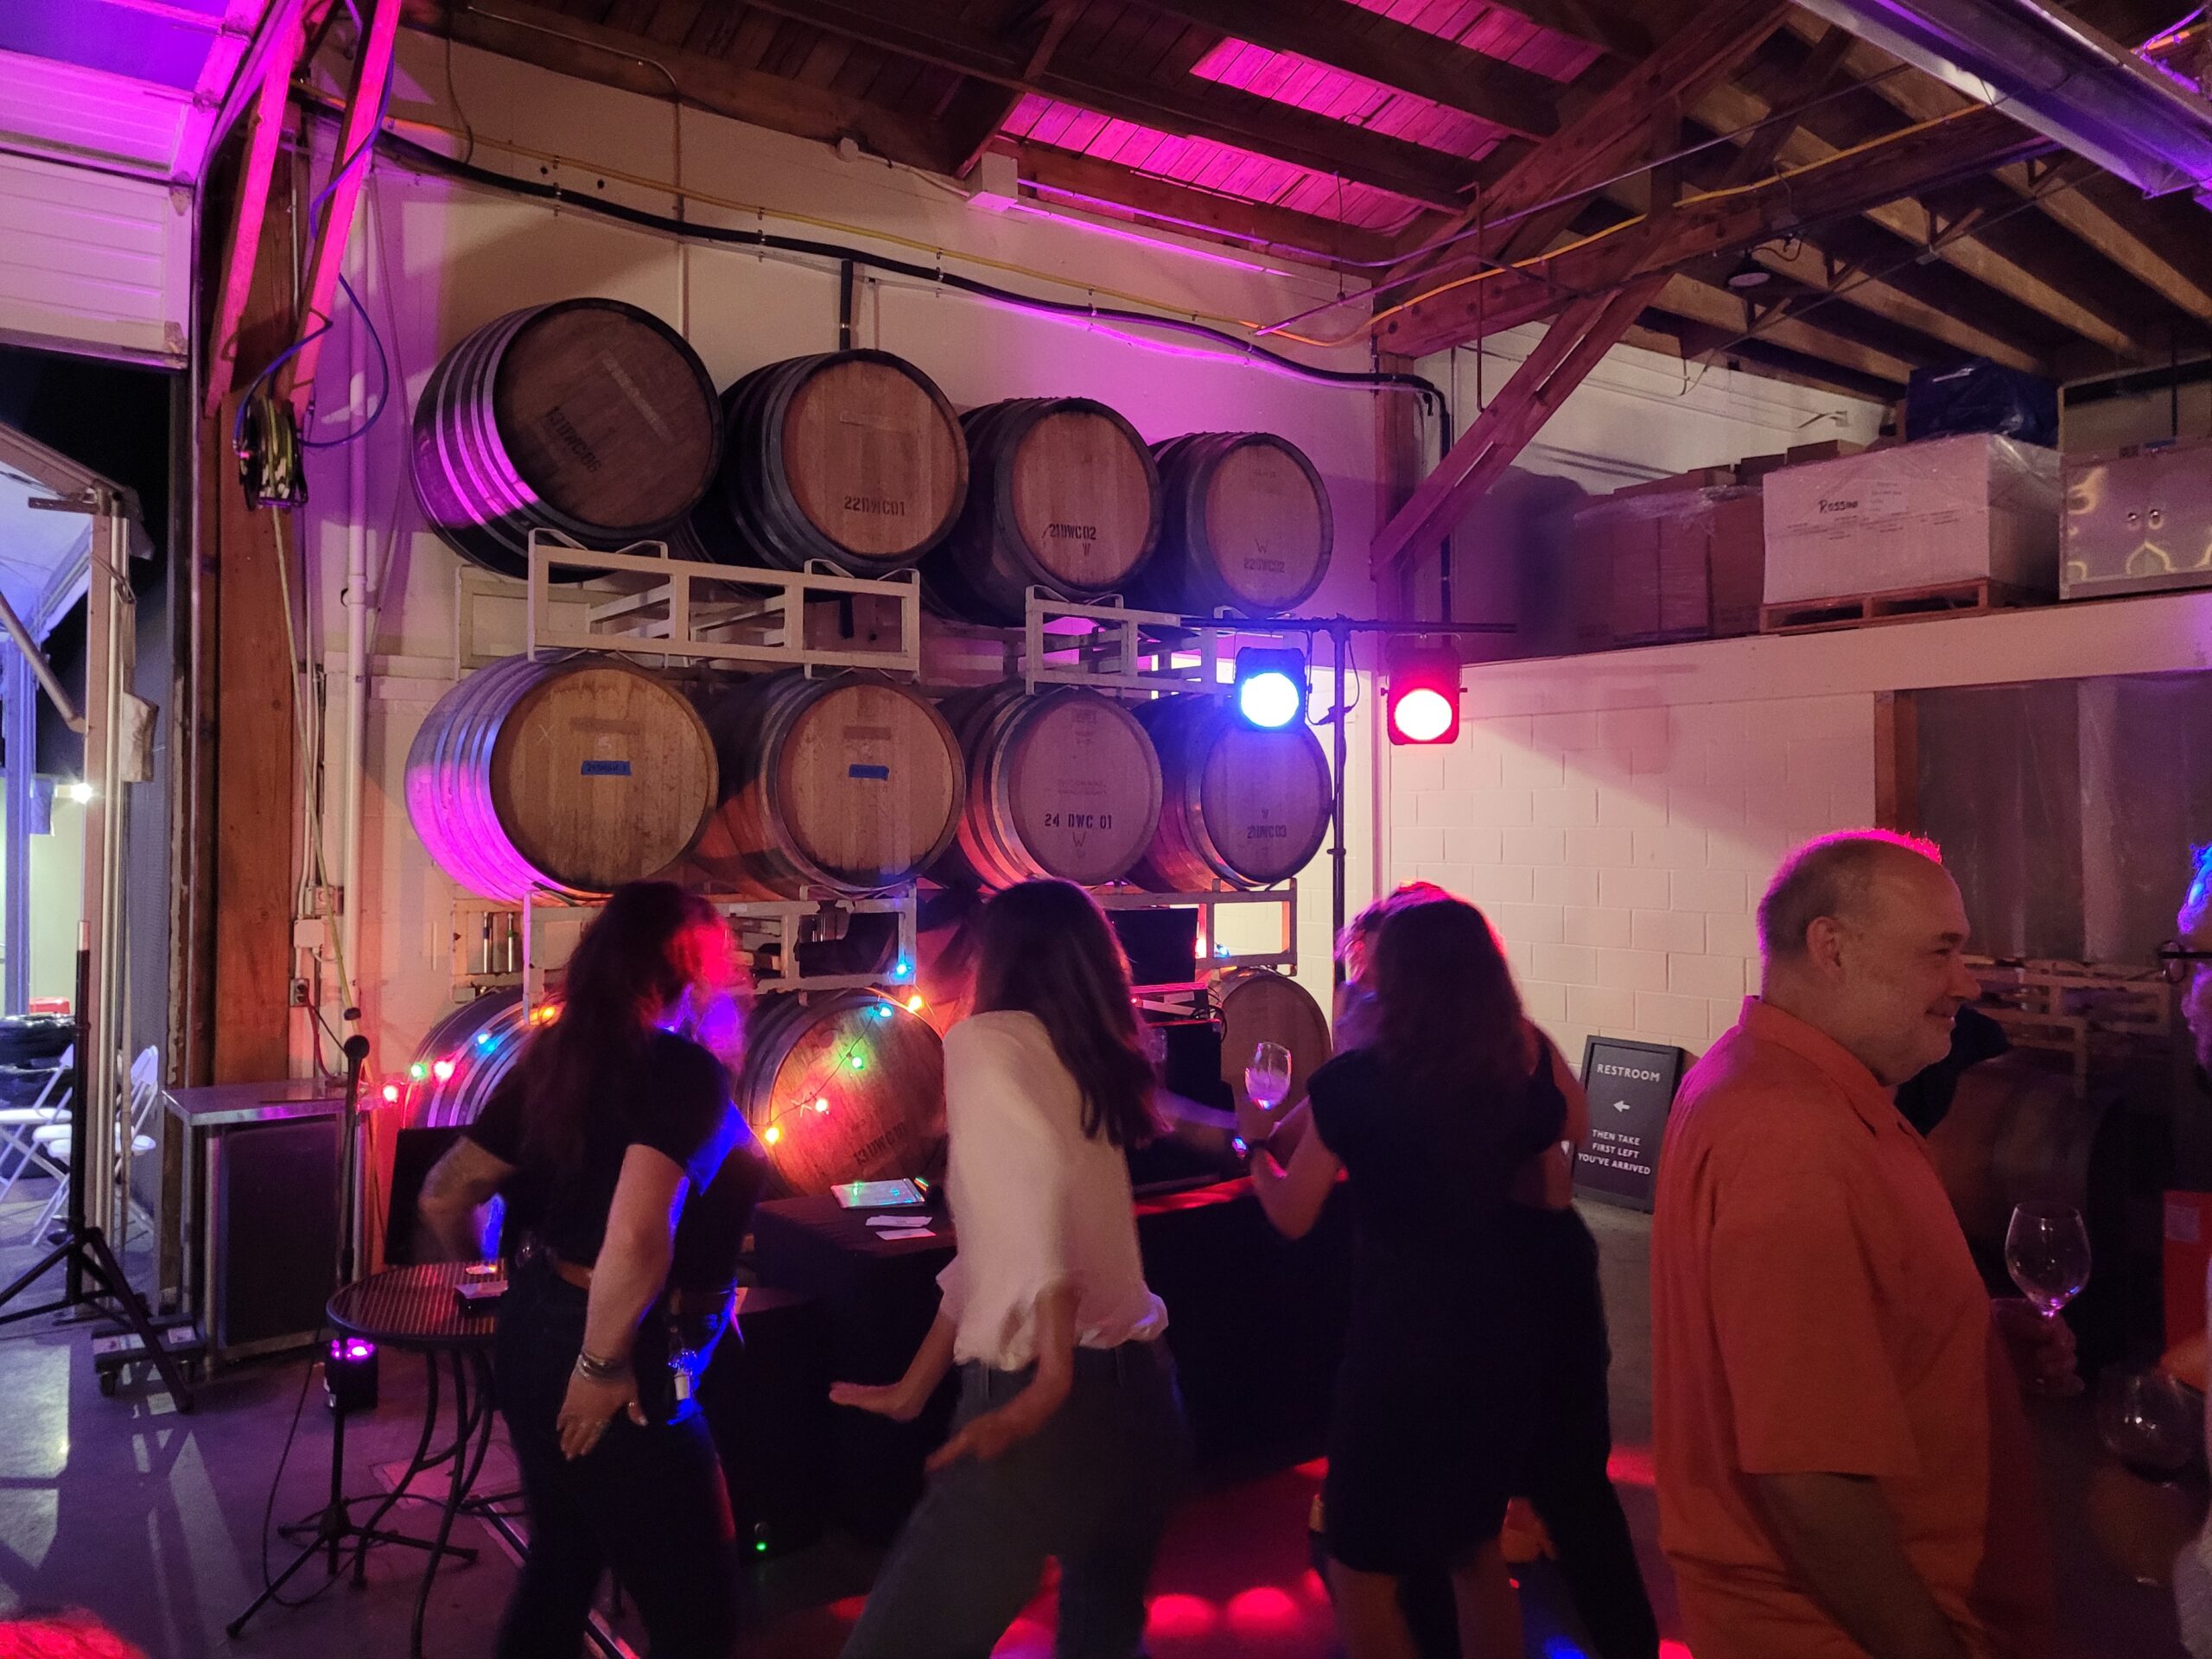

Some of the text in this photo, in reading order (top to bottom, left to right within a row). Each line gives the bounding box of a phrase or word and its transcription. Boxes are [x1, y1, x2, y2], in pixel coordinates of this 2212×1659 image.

[1044, 813, 1112, 830] 24 DWC 01
[1596, 1063, 1661, 1083] RESTROOM
[1592, 1128, 1641, 1147] THEN TAKE
[1592, 1142, 1641, 1159] FIRST LEFT
[1578, 1152, 1651, 1175] YOU'VE ARRIVED
